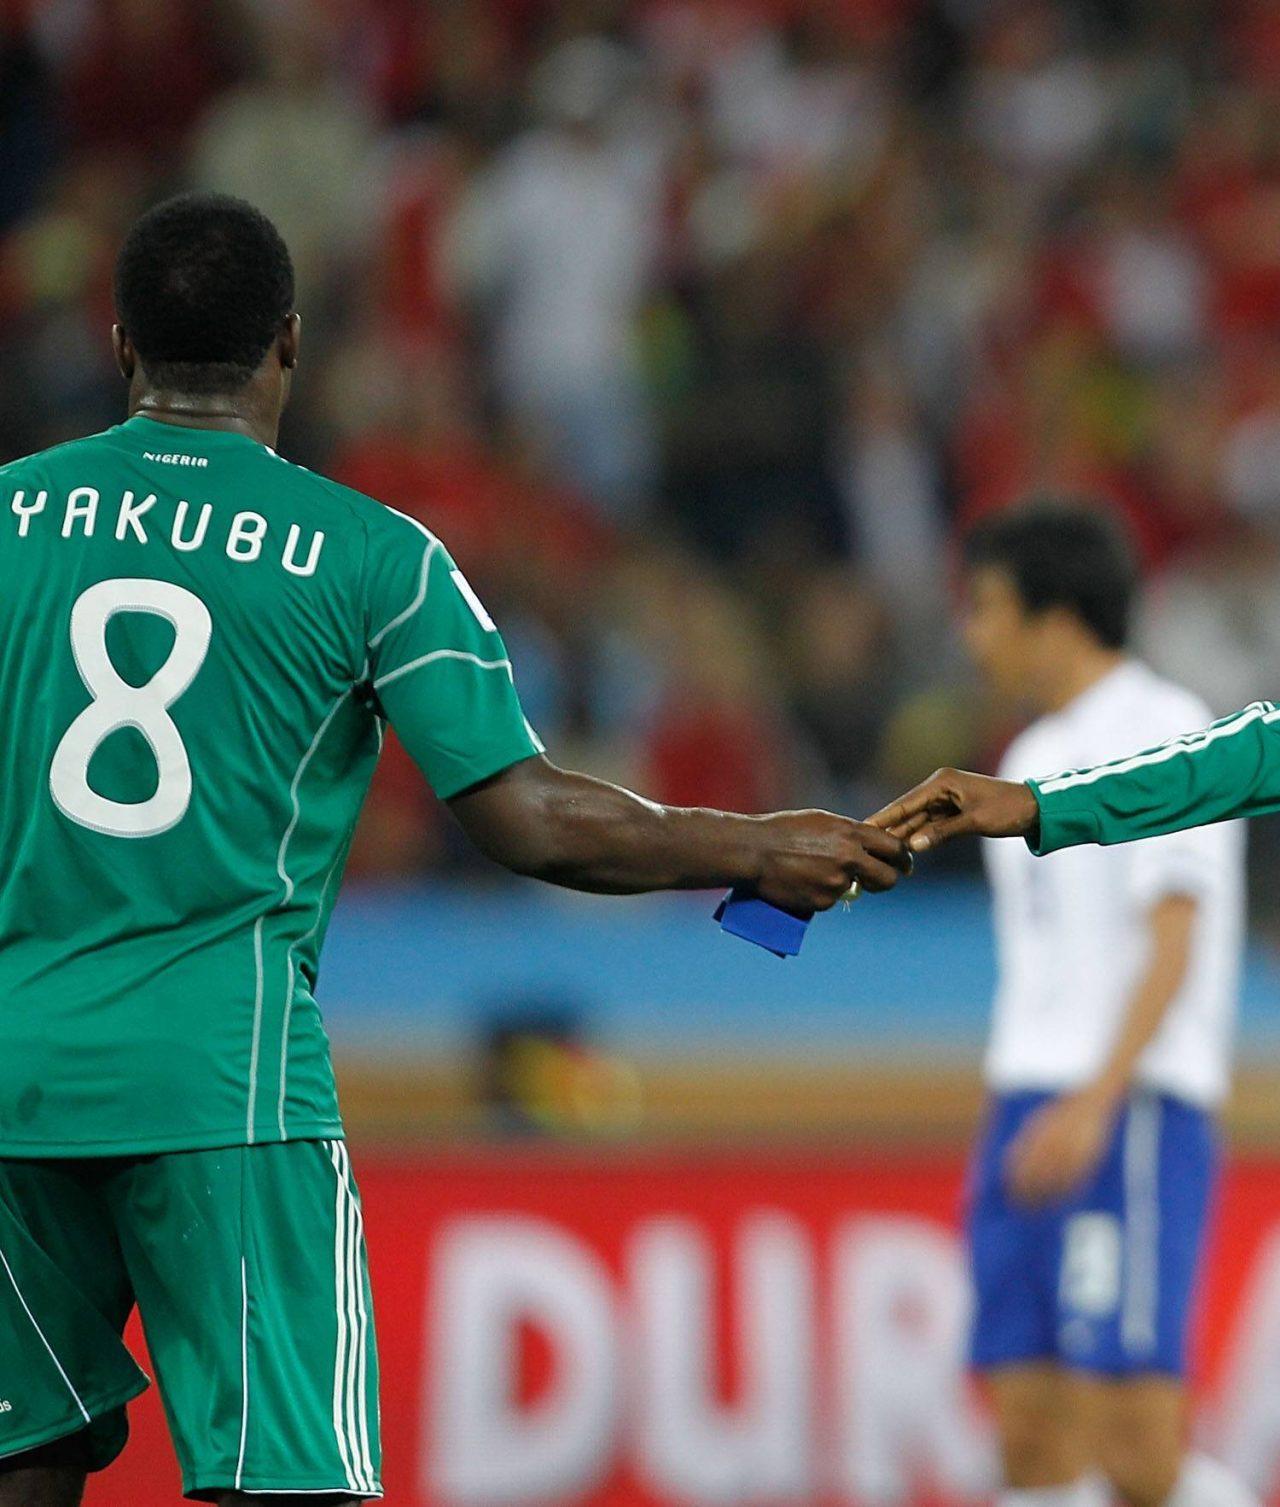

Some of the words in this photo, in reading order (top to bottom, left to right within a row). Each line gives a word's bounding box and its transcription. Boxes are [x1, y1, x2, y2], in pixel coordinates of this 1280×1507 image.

[143, 452, 208, 468] NIGERIA
[11, 487, 325, 577] YAKUBU
[49, 578, 212, 839] 8
